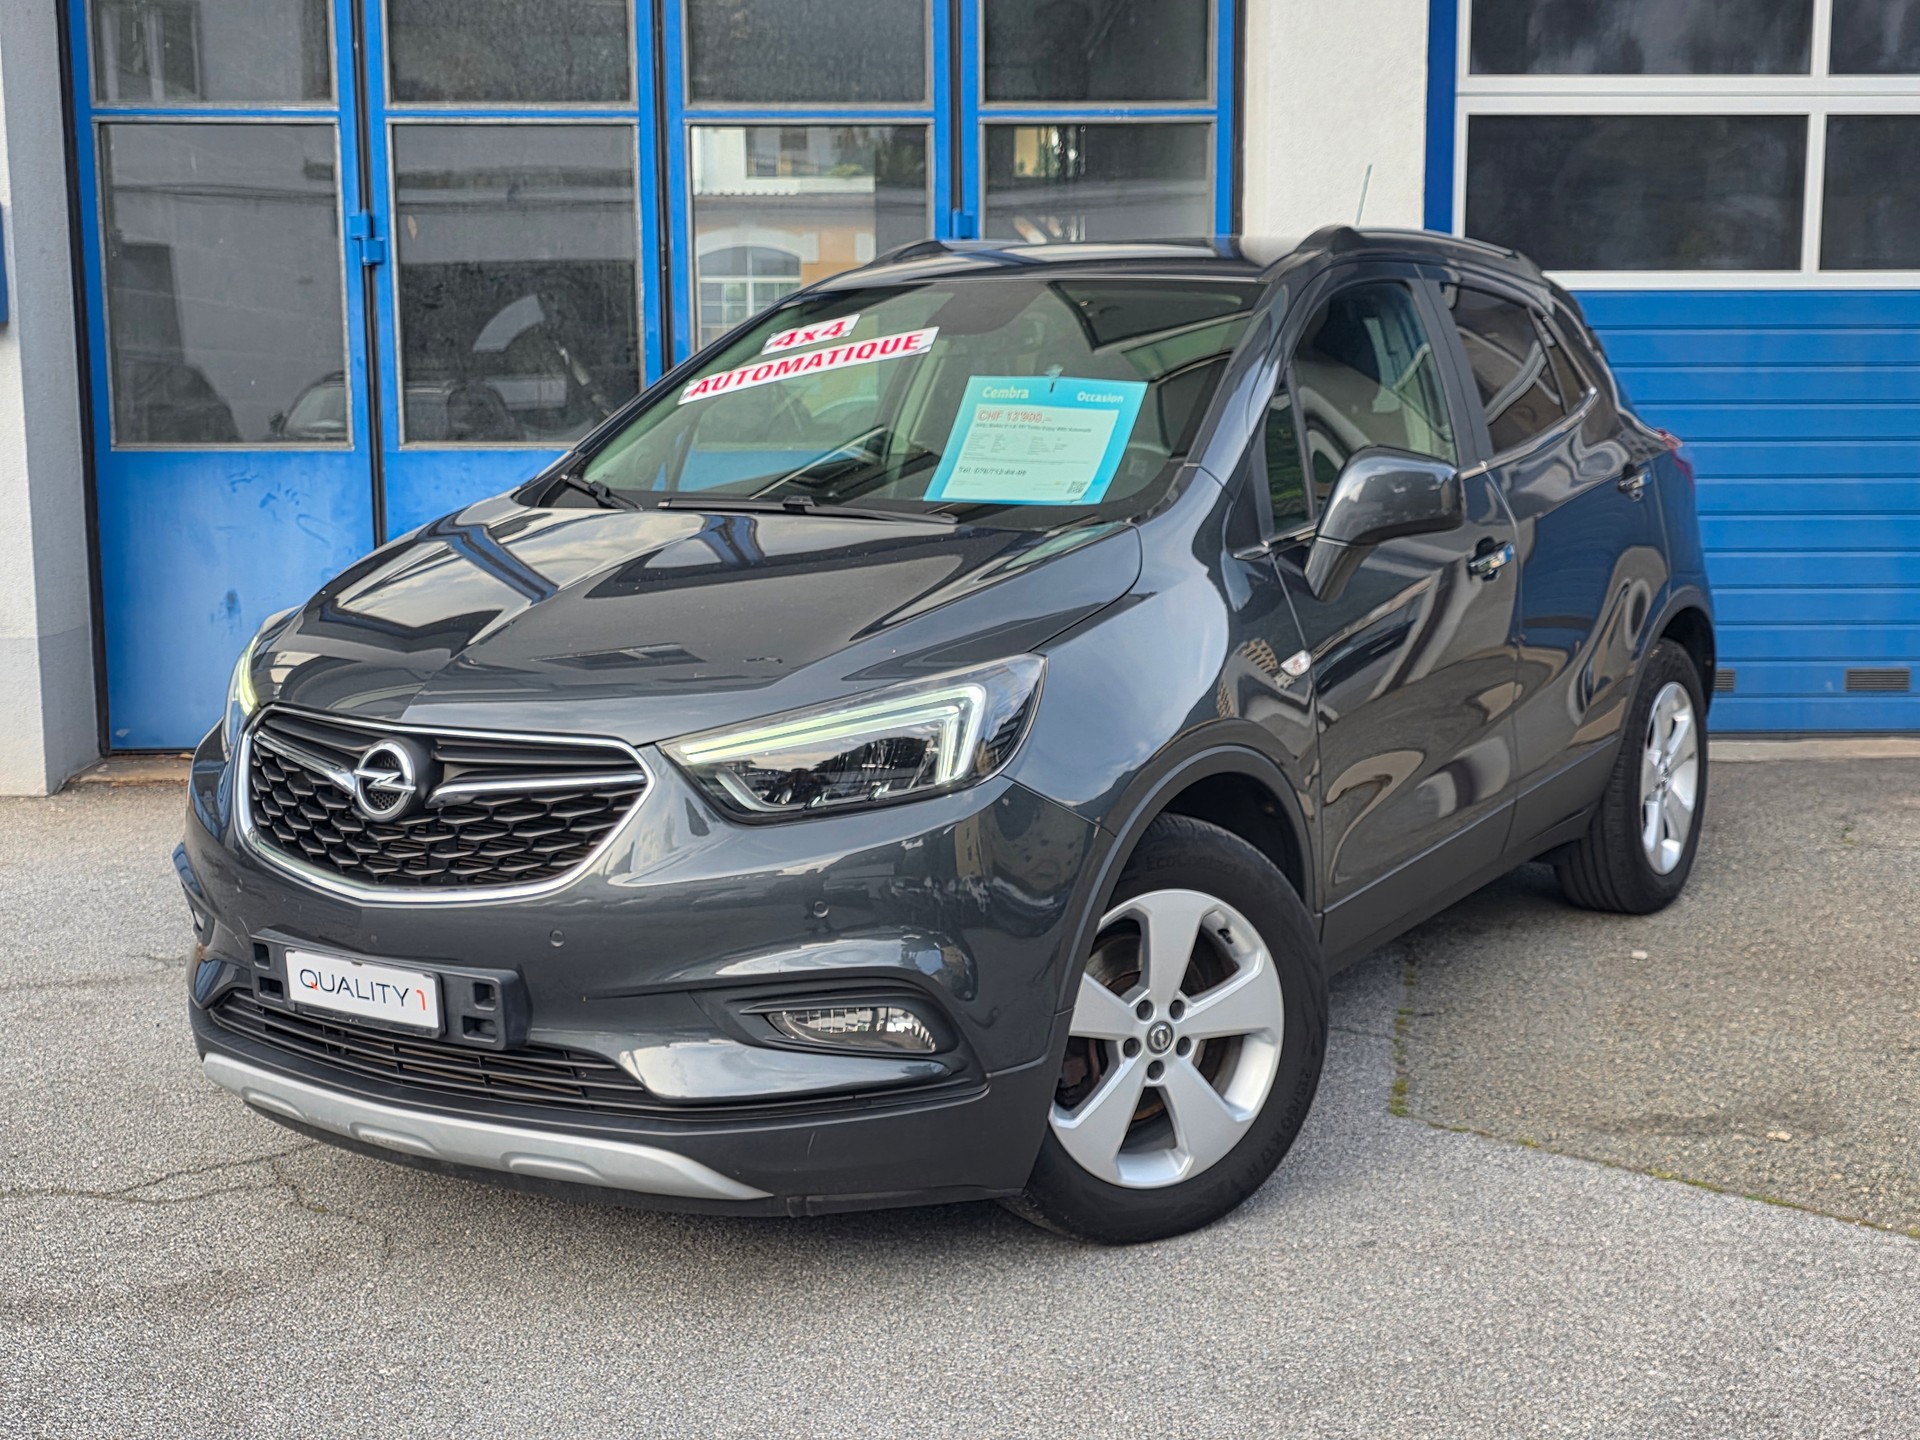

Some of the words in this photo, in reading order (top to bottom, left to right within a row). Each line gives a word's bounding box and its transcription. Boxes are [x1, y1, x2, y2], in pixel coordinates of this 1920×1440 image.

[773, 321, 846, 348] 4x4
[689, 333, 924, 397] AUTOMATIQUE
[982, 385, 1030, 399] Cembra
[1077, 391, 1124, 403] Occasion
[978, 410, 1003, 421] CHF
[299, 968, 410, 1007] QUALITY
[415, 988, 426, 1011] 1
